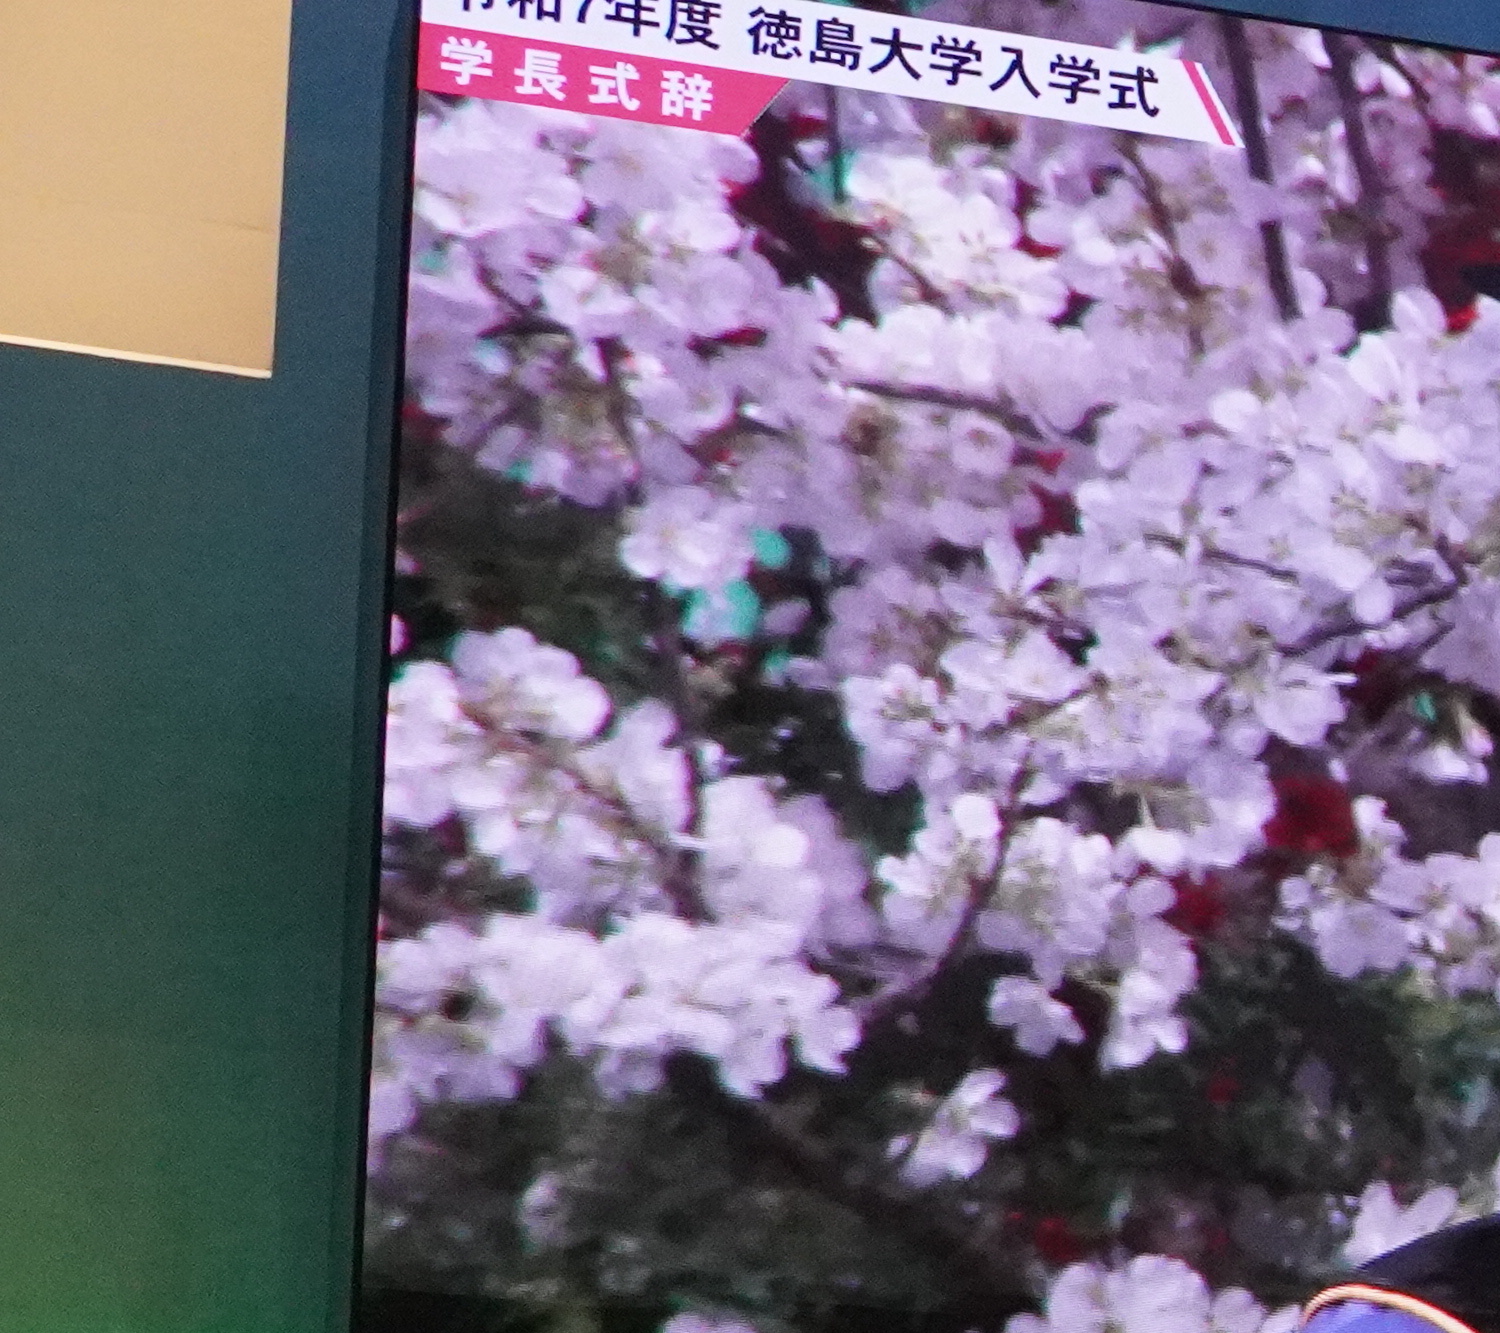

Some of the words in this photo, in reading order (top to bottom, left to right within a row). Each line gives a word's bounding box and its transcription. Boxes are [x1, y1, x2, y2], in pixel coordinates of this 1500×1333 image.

[440, 36, 713, 121] 学長式辞
[747, 6, 1159, 118] 徳島大学入学式
